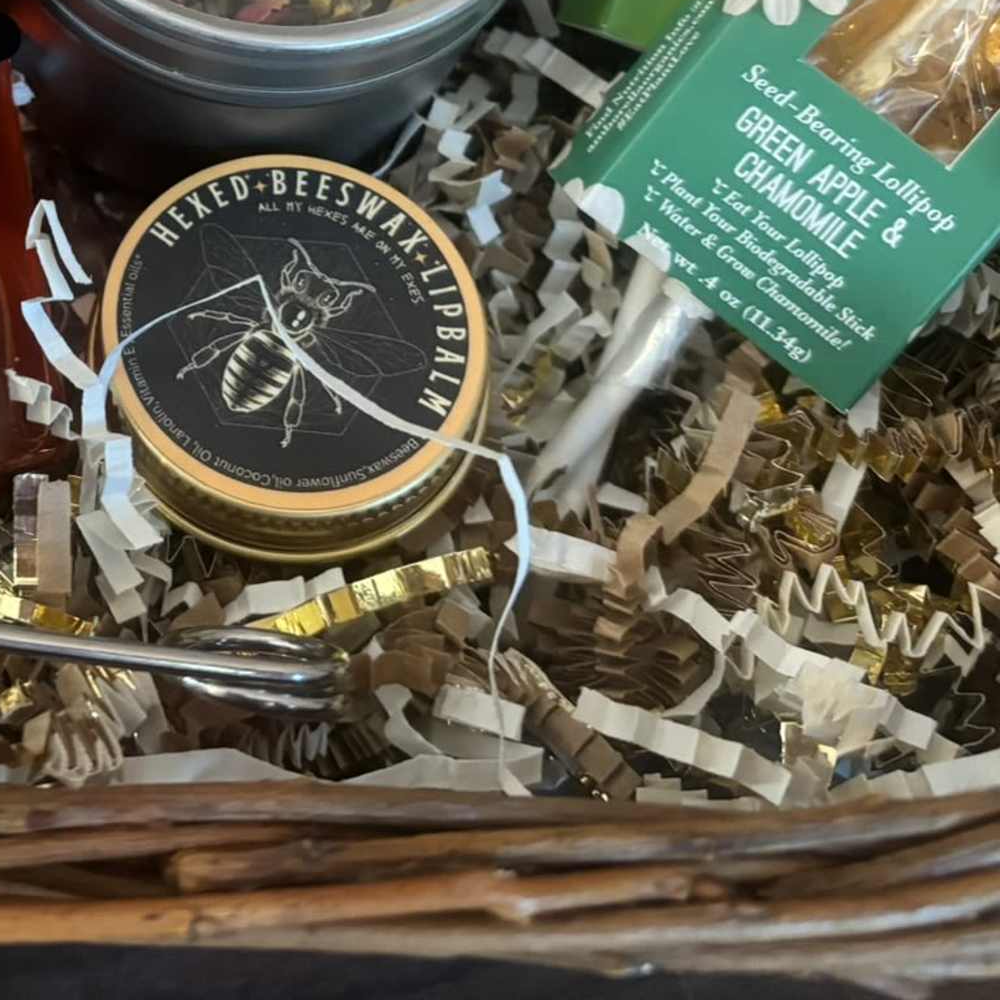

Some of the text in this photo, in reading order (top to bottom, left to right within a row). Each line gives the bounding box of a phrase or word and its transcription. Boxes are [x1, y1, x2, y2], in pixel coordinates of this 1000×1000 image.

[735, 105, 907, 249] GREEN APPLE &
[741, 63, 956, 233] Seed-Bearing Lollipop
[149, 175, 249, 248] HEXED
[271, 169, 428, 254] BEESWAX
[258, 202, 426, 306] ALL MY HEXES ARE ON MY EXES
[661, 171, 878, 342] Plant Your Biodegradable Stick
[722, 190, 846, 289] Eat Your Lollipop
[733, 151, 867, 259] CHAMOMILE
[658, 198, 854, 351] Water & Grow Chamomile!
[719, 288, 743, 309] oz
[742, 304, 813, 364] (11.34g)
